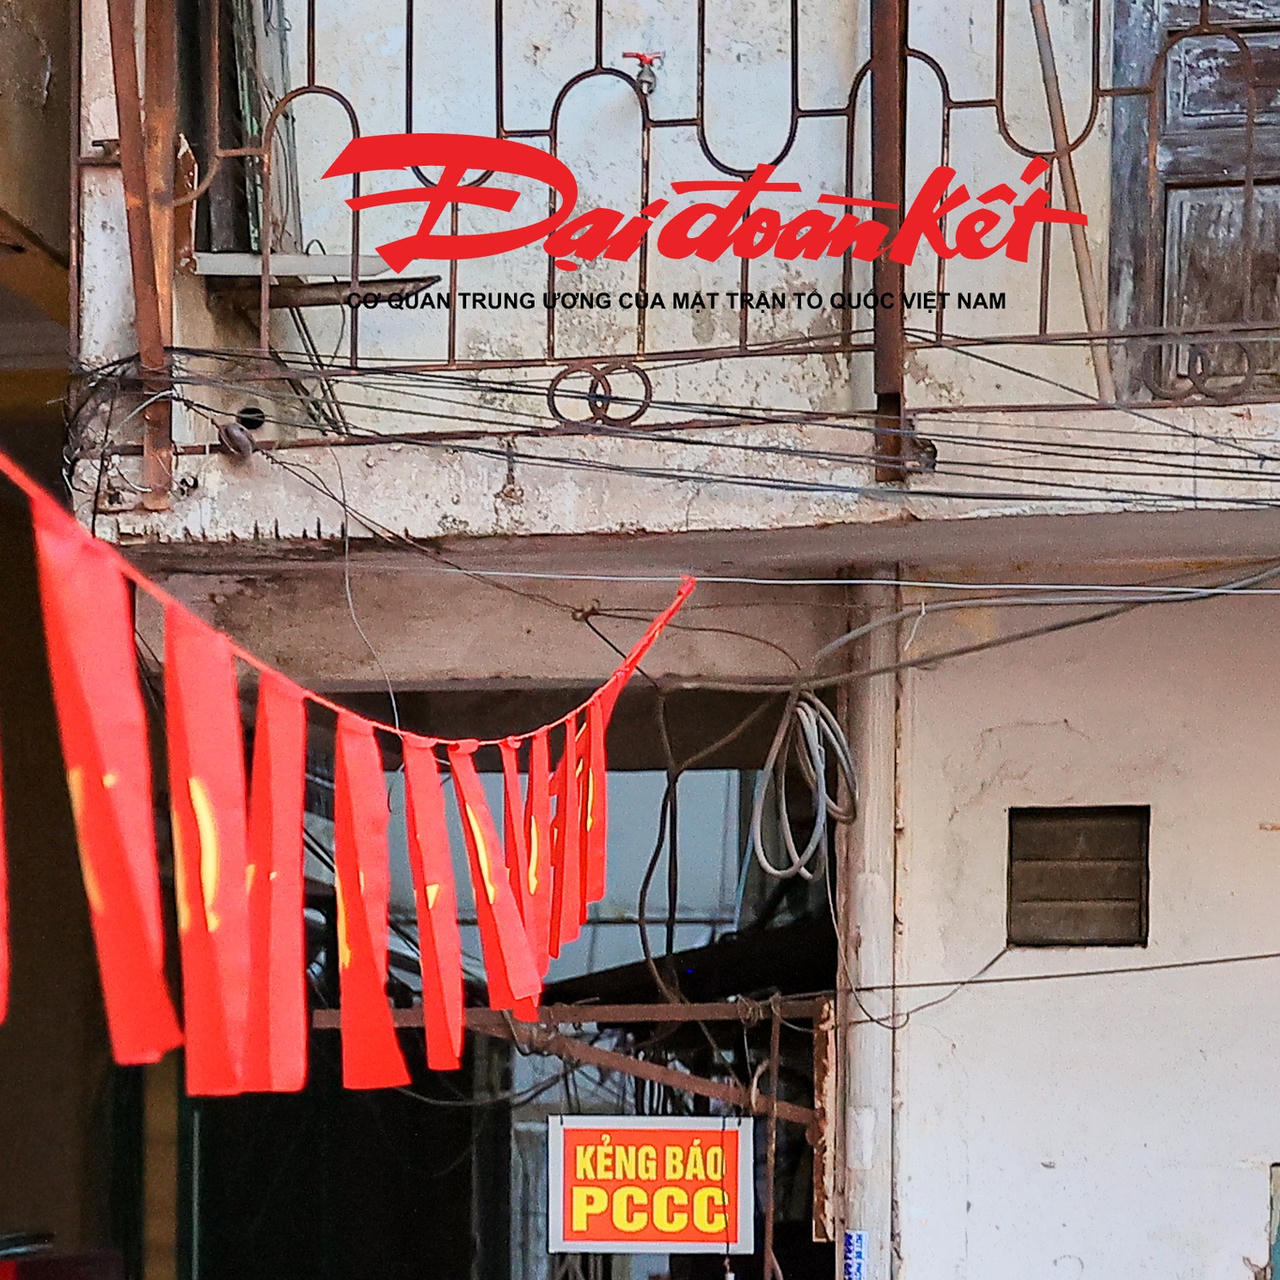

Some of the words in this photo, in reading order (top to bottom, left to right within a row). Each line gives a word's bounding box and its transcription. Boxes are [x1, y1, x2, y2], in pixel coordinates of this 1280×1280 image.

[575, 1134, 657, 1181] KẺNG
[665, 1139, 725, 1181] BÁO
[571, 1186, 729, 1234] PCCC
